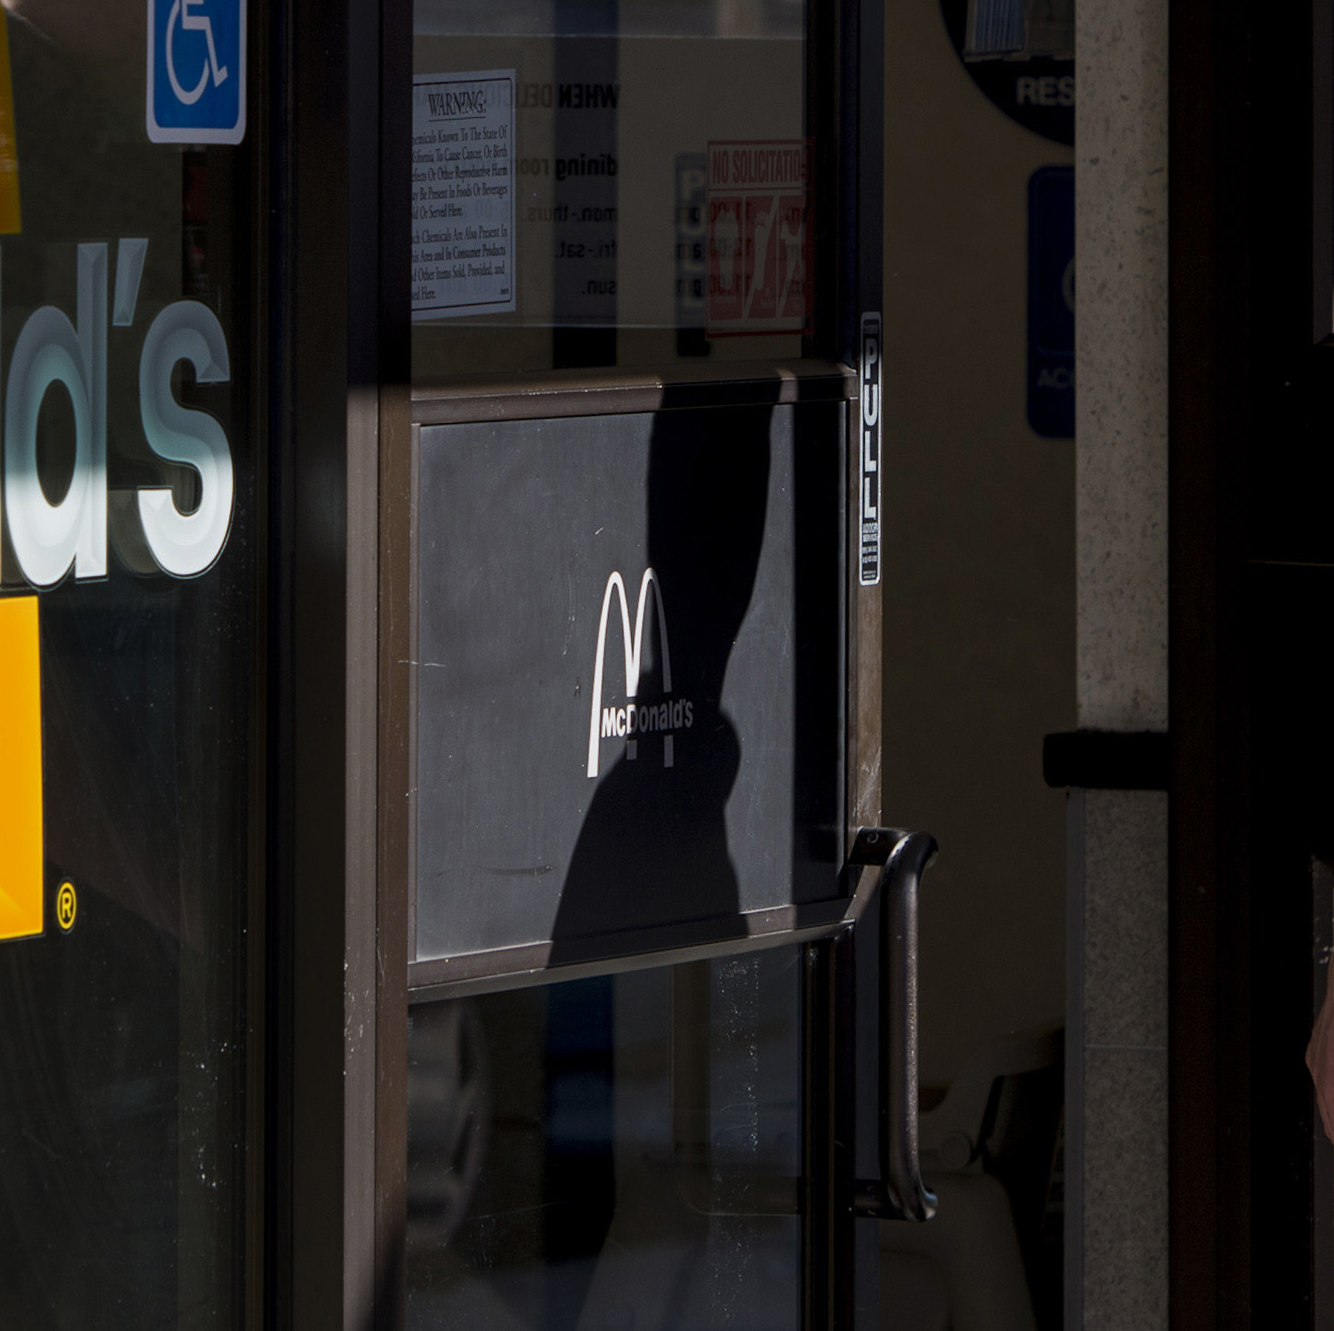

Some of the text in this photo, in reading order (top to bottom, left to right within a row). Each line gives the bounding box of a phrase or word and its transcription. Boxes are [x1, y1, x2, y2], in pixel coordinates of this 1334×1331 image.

[428, 90, 486, 117] WARNING:
[438, 130, 458, 143] Known
[460, 128, 468, 141] To
[470, 127, 481, 141] The
[483, 126, 497, 140] State
[499, 125, 508, 139] Of
[436, 149, 443, 162] To
[444, 148, 461, 161] Cause
[484, 145, 492, 159] Or
[493, 143, 507, 158] Birth
[428, 167, 436, 181] Or
[437, 167, 453, 180] Other
[455, 164, 490, 183] Reproductive
[492, 163, 507, 176] Harm
[712, 150, 804, 183] NO SOLICITATIO
[420, 187, 427, 201] Be
[429, 186, 448, 200] Present
[449, 185, 455, 198] In
[456, 183, 472, 197] Foods
[473, 182, 481, 196] Or
[482, 182, 507, 199] Beverages
[420, 206, 428, 220] Or
[429, 204, 447, 218] Served
[448, 203, 463, 217] Here.
[422, 227, 451, 244] Chemicals
[453, 228, 462, 241] Are
[465, 226, 477, 240] Also
[479, 225, 499, 239] Present
[501, 224, 507, 237] In
[420, 250, 432, 262] Area
[434, 247, 444, 261] and
[445, 247, 452, 260] In
[453, 246, 480, 259] Consumer
[482, 243, 505, 257] Products
[418, 267, 434, 281] Other
[436, 266, 451, 279] Items
[494, 260, 505, 274] and
[864, 338, 878, 520] PULL
[601, 698, 694, 738] McDonald's
